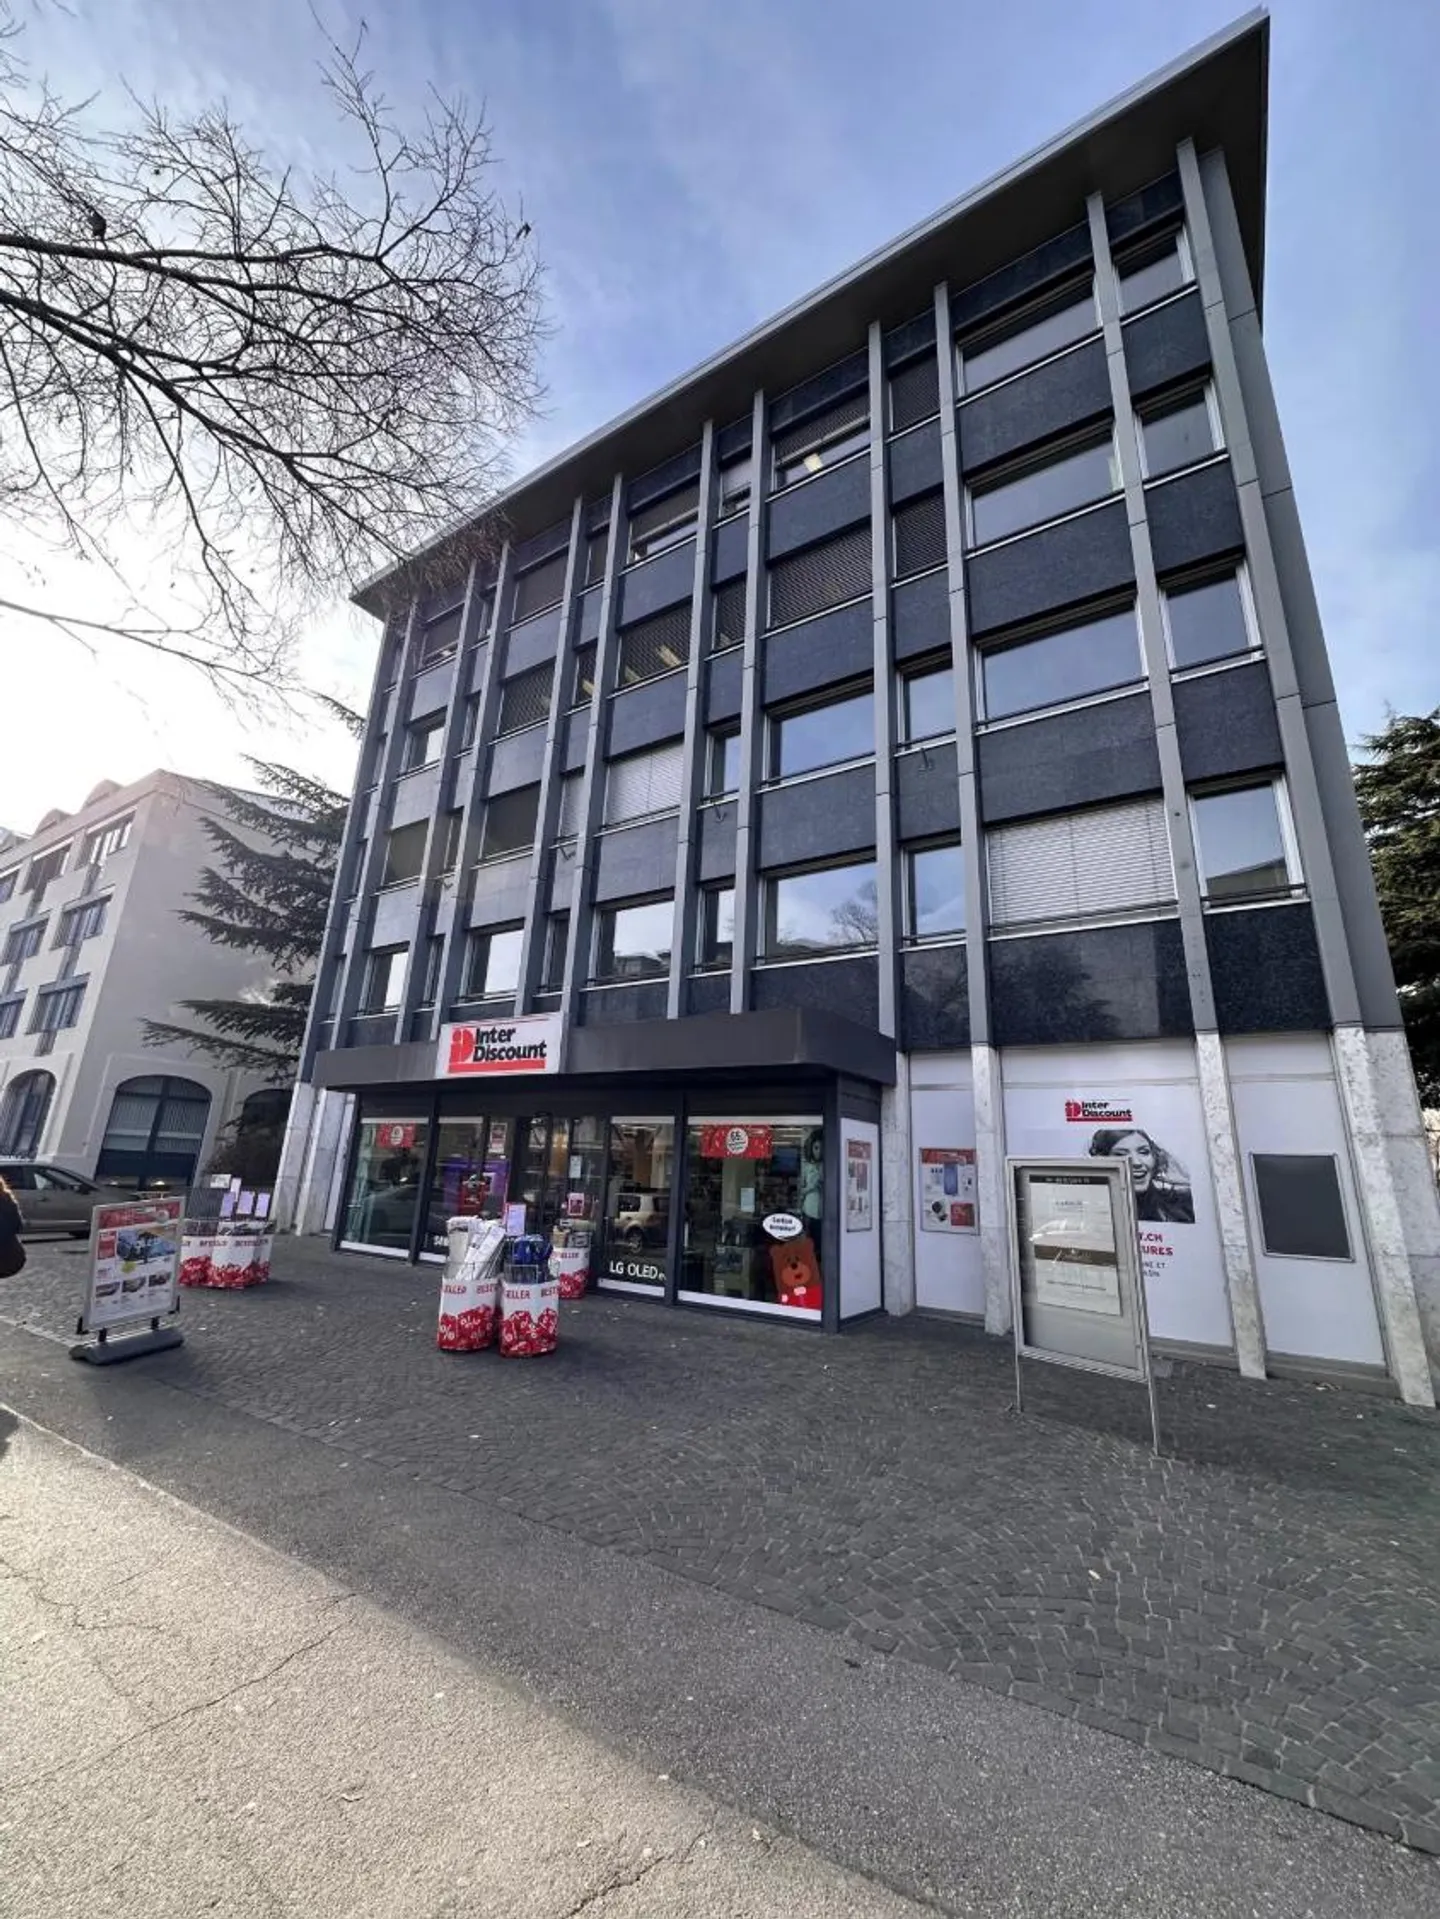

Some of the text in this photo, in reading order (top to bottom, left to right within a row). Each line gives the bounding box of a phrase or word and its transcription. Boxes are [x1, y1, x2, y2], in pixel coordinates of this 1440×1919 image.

[475, 1027, 516, 1044] Inter
[473, 1040, 547, 1062] Discount
[1081, 1101, 1109, 1109] Inter
[1082, 1109, 1132, 1117] Discount
[609, 1261, 624, 1275] LG
[627, 1263, 658, 1279] OLED
